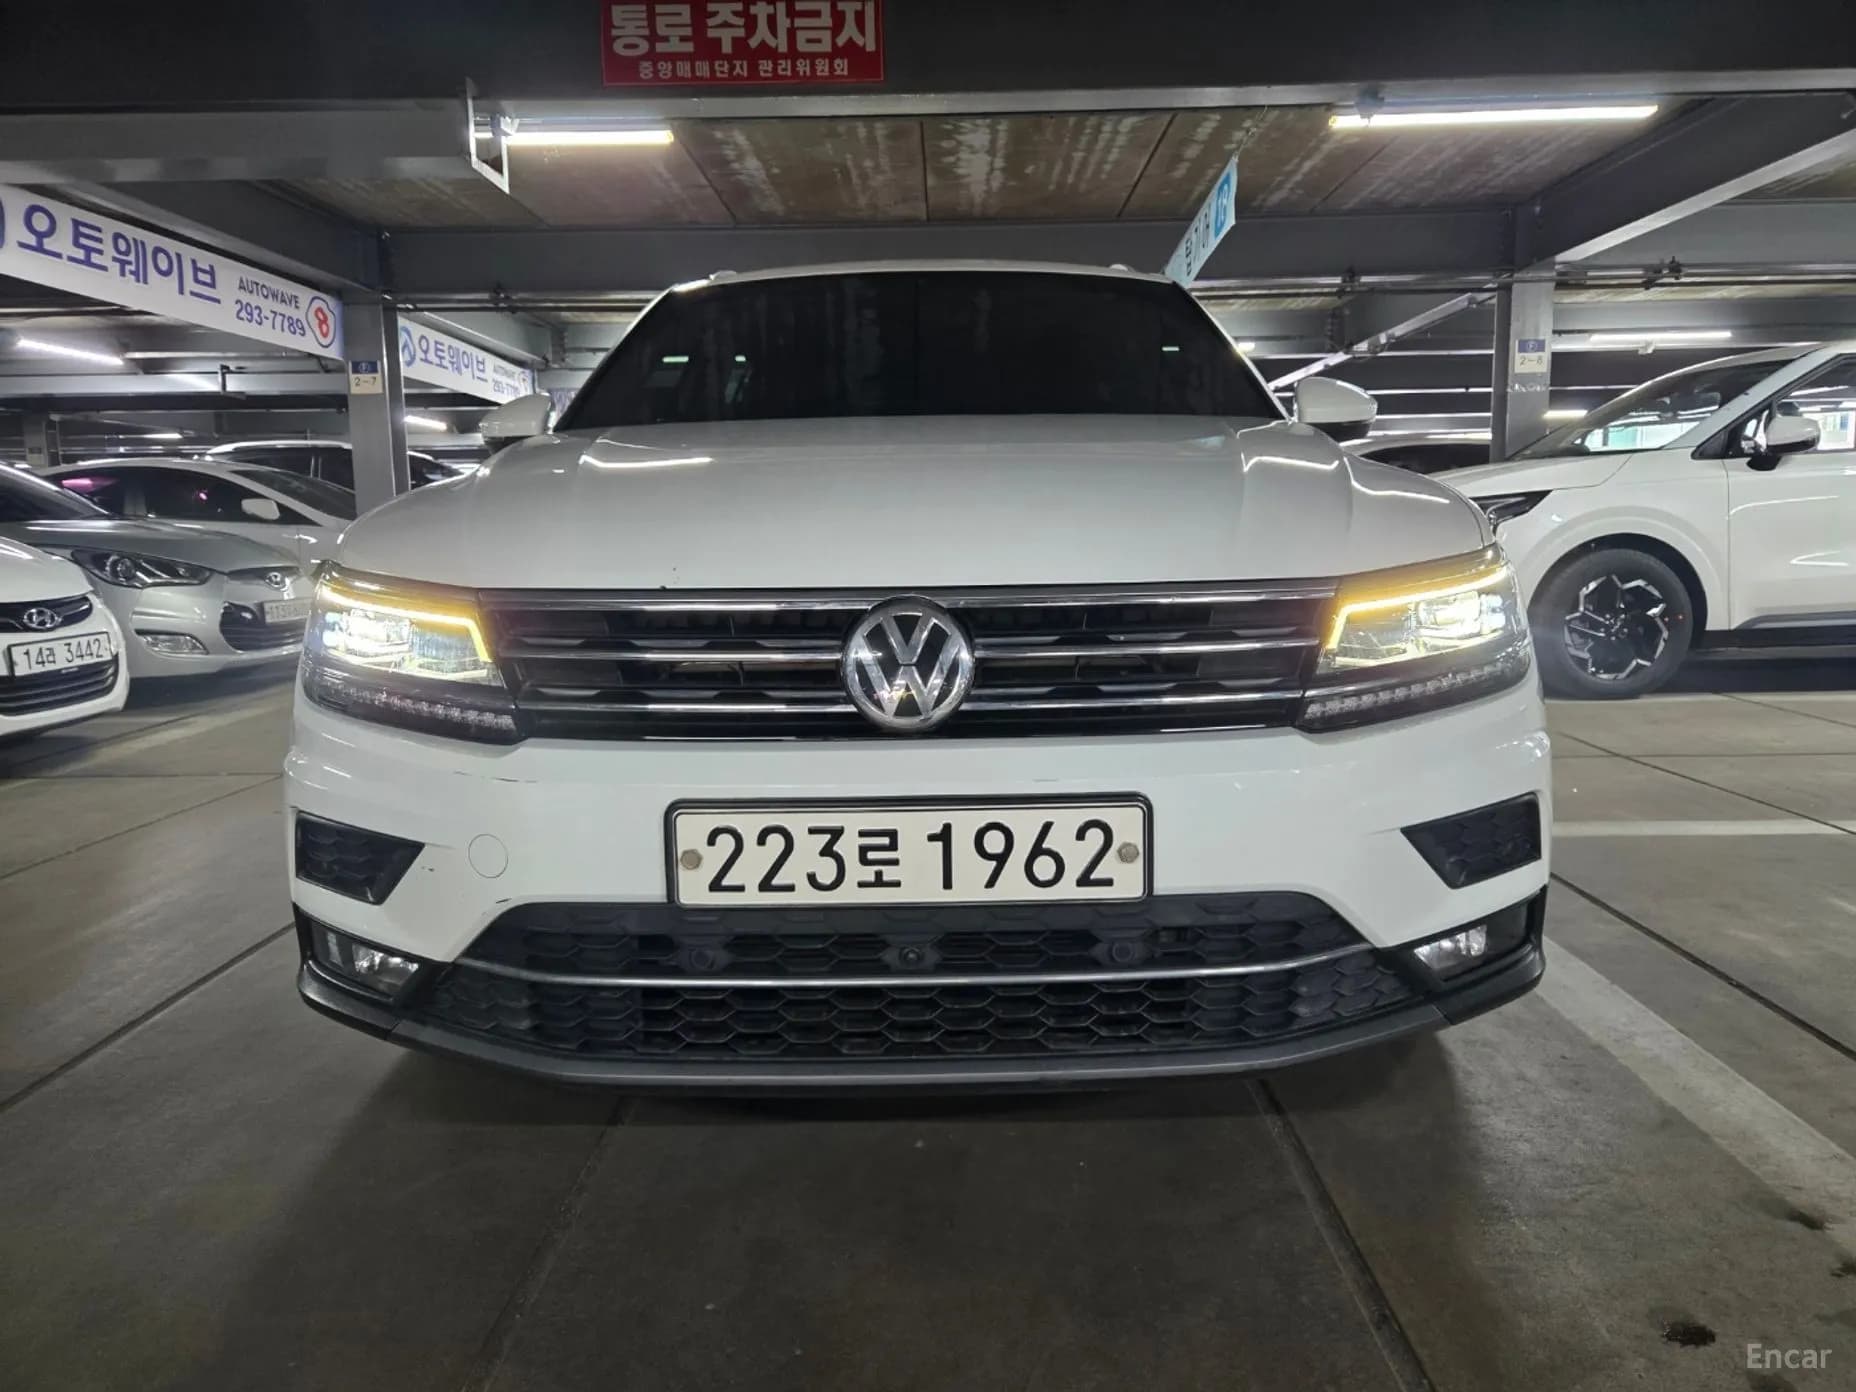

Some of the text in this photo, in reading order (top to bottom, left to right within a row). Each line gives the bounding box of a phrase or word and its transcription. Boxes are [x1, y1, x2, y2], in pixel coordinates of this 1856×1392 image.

[610, 0, 877, 57] 통로 주차금지
[638, 58, 849, 80] 중앙매매단지 관리위원회
[16, 204, 222, 305] 오토웨이브
[238, 276, 300, 310] AUTOWAVE
[235, 299, 306, 337] 293-7789
[418, 335, 489, 383] 오토웨이브
[354, 376, 377, 388] 2-7
[63, 637, 104, 664] 3442
[706, 818, 1115, 893] 223로 1962
